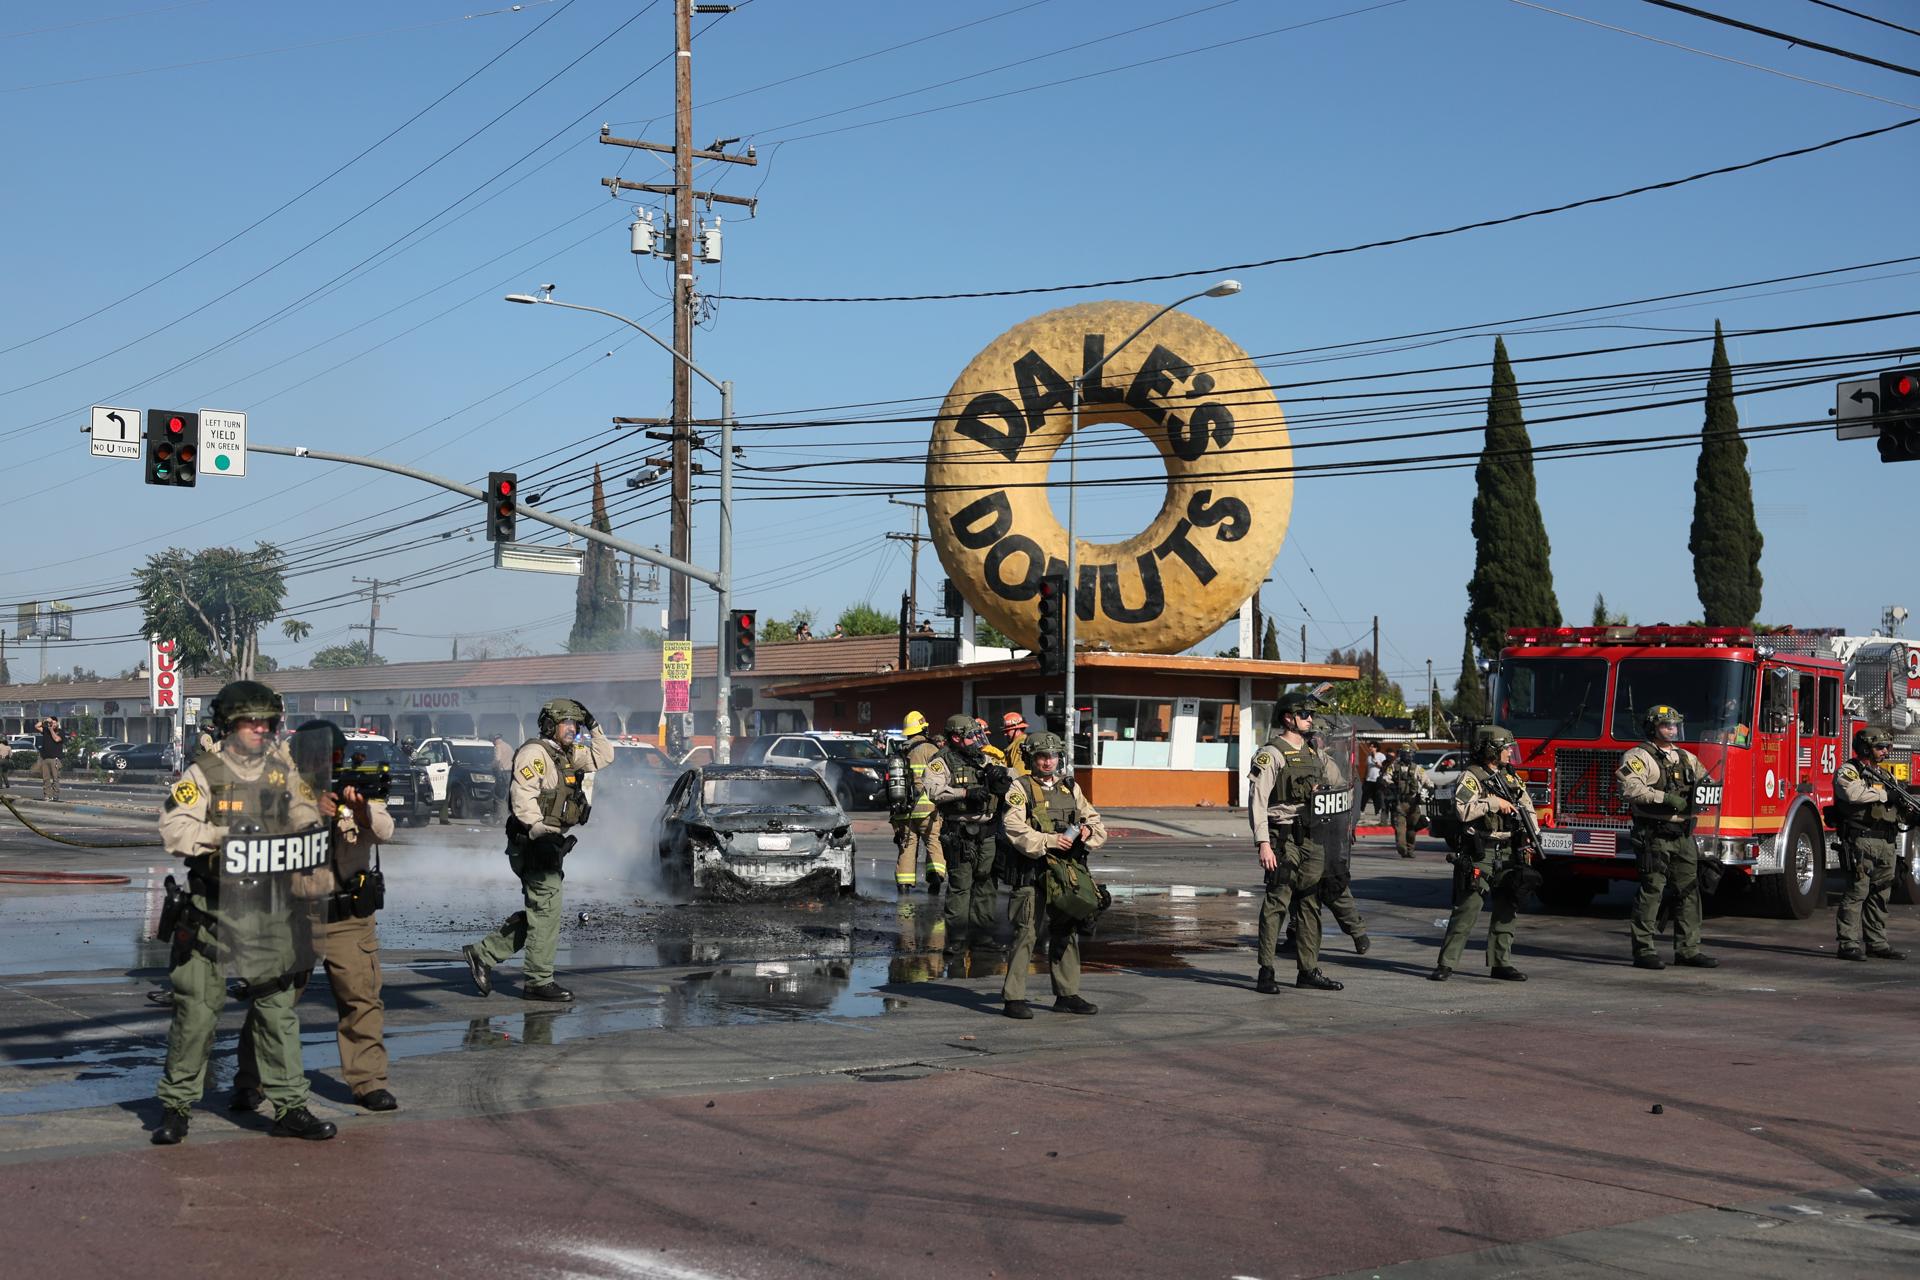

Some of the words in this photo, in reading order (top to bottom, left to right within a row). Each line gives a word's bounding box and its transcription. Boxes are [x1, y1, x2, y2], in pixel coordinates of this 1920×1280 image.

[954, 334, 1235, 462] DALE'S
[205, 418, 221, 427] LEFT
[223, 420, 241, 428] TURN
[210, 430, 236, 440] YIELD
[106, 443, 115, 453] U
[118, 446, 138, 454] TURN
[218, 443, 240, 451] GREEN
[950, 489, 1252, 623] DONUTS
[412, 692, 460, 709] LIQUOR
[1821, 744, 1836, 774] 45
[1543, 839, 1572, 848] 1260919
[225, 831, 329, 874] SHERIFF
